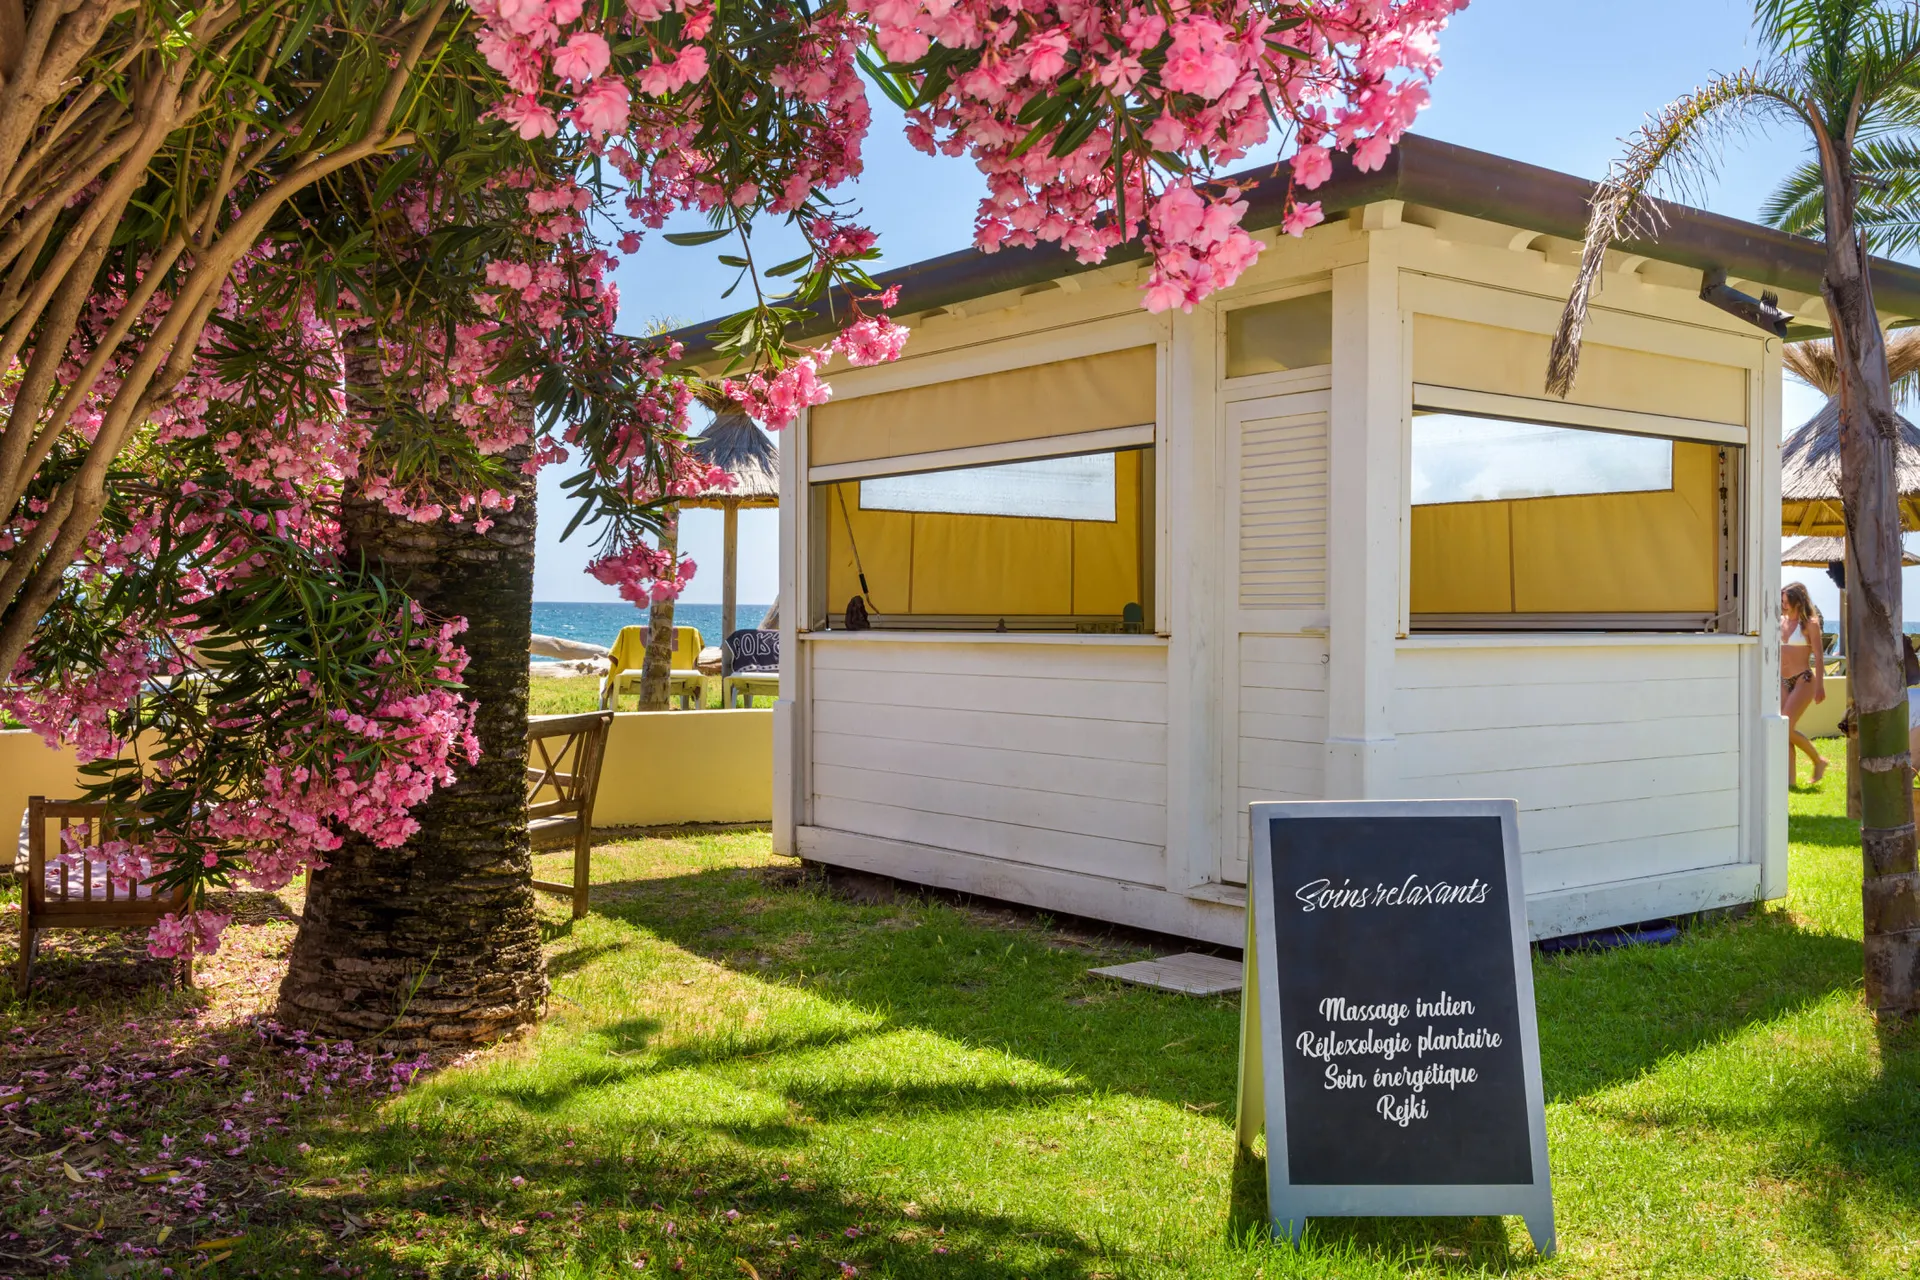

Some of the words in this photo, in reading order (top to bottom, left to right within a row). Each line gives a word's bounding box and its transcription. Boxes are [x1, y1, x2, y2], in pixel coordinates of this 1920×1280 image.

[1295, 878, 1371, 912] Soins
[1371, 874, 1492, 907] relaxants
[1319, 997, 1410, 1026] Massage
[1416, 991, 1475, 1018] indien
[1296, 1028, 1411, 1062] Réflexologie
[1418, 1025, 1502, 1058] plantaire
[1324, 1063, 1367, 1090] Soin
[1373, 1062, 1478, 1093] énergétique
